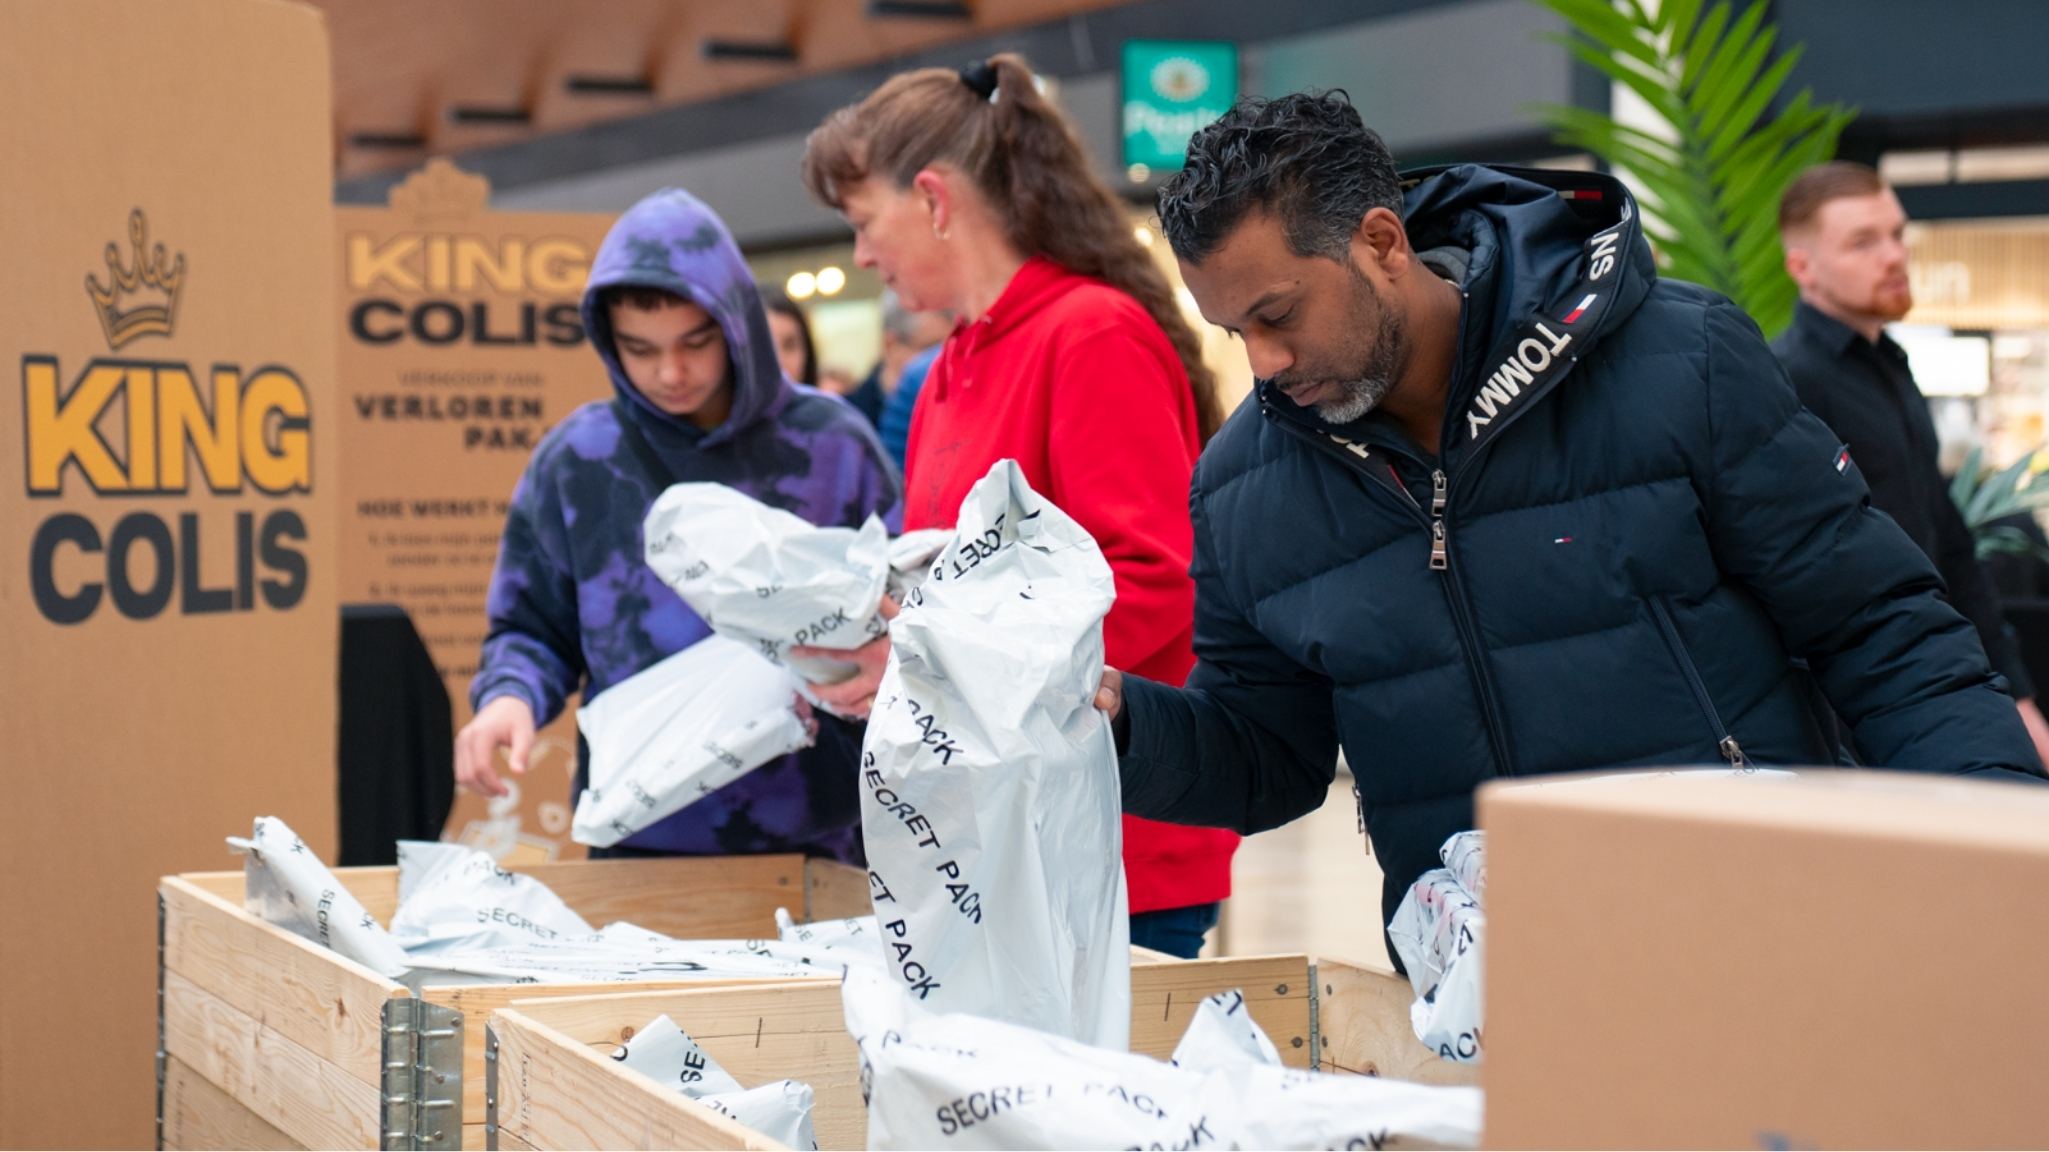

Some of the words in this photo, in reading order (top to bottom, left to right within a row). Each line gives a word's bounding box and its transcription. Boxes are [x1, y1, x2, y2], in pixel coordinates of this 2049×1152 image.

[347, 232, 593, 297] KING
[350, 299, 586, 346] COLIS
[354, 395, 544, 420] VERLOREN
[1466, 322, 1573, 440] TOMMY
[22, 354, 313, 497] KING
[463, 426, 550, 449] PAK
[29, 509, 309, 626] COLIS
[795, 608, 853, 646] PACK
[477, 907, 559, 941] SECRET
[886, 919, 941, 1000] PACK
[936, 1084, 1053, 1137] SECRET
